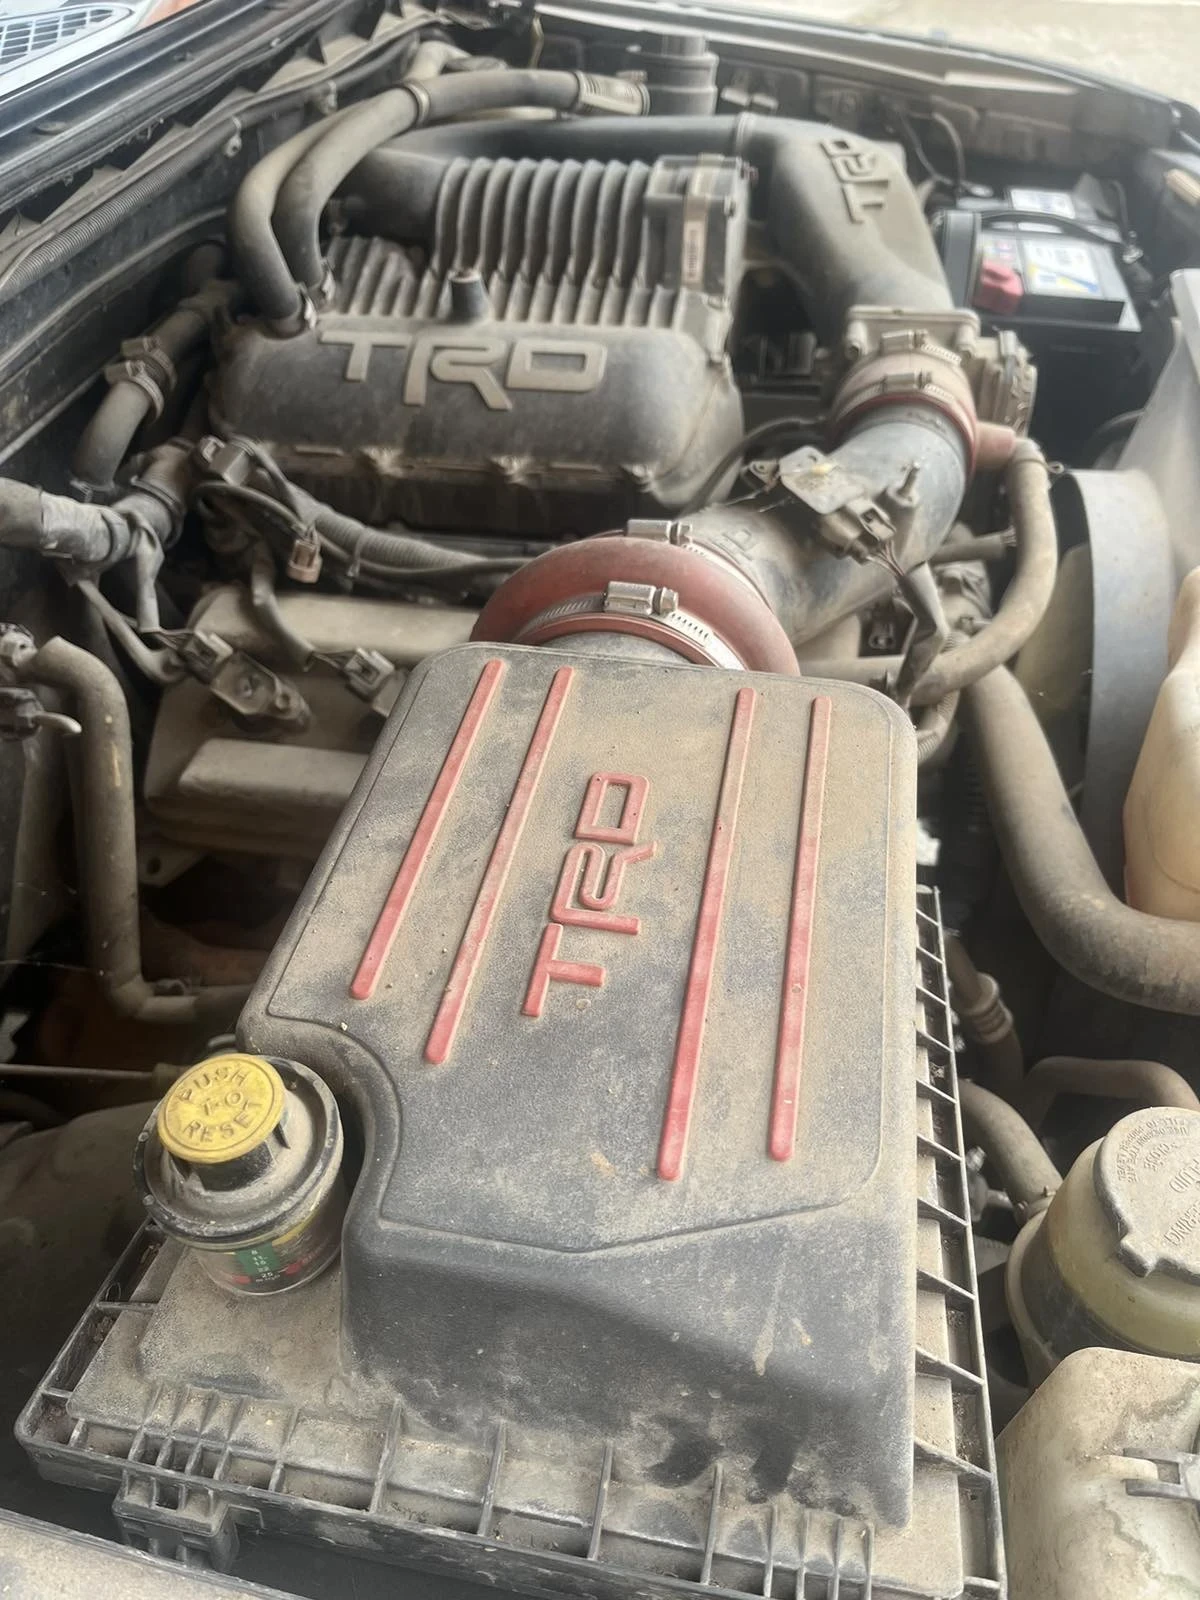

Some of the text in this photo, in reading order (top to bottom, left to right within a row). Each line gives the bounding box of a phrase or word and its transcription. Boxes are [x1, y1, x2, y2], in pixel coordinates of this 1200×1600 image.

[819, 136, 888, 224] TRD
[318, 330, 607, 410] TRD
[521, 771, 657, 1017] TRD
[178, 1067, 248, 1102] PUSH
[202, 1091, 243, 1116] TO
[183, 1100, 263, 1143] RESET
[1163, 1200, 1200, 1247] ERING
